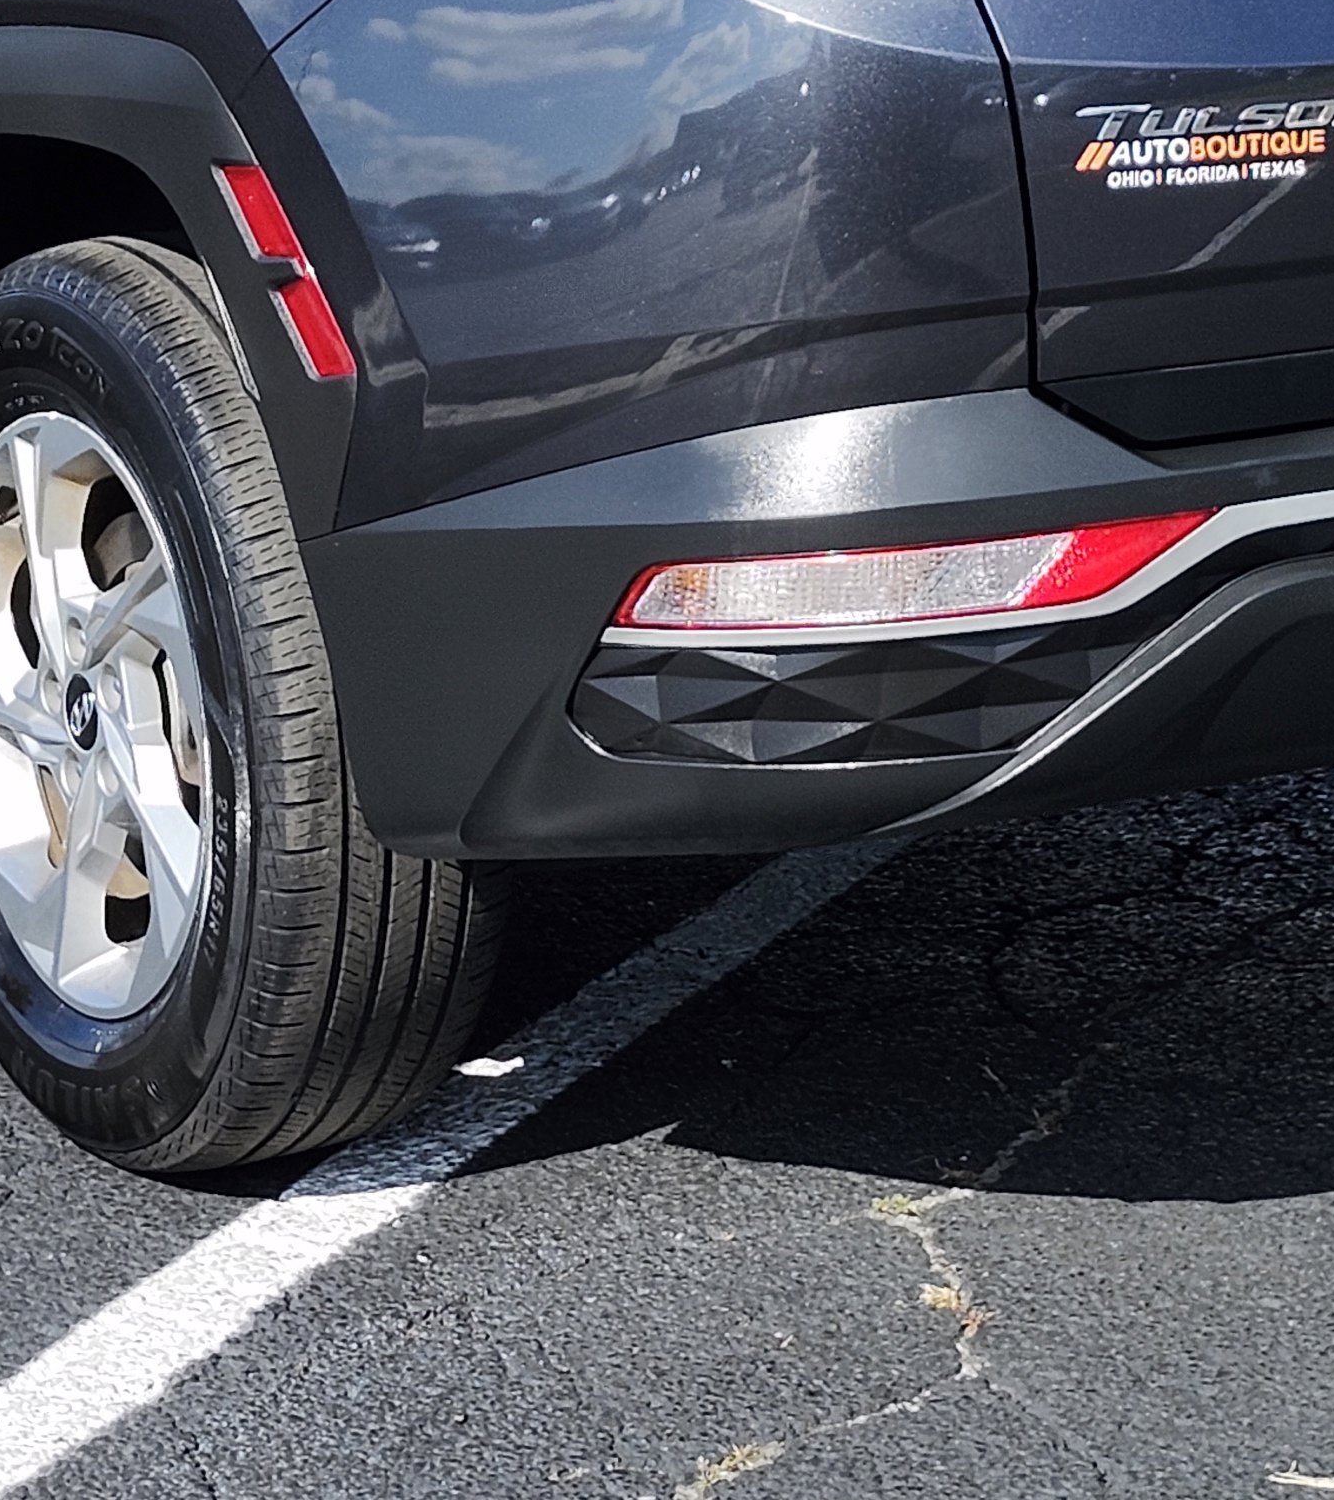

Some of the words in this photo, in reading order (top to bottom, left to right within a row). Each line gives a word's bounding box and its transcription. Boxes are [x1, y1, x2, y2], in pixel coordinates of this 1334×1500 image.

[1110, 129, 1328, 167] AUTOBOUTIQUE
[1107, 168, 1154, 189] OHIO
[1166, 164, 1240, 186] FLORIDA
[1249, 159, 1307, 180] TEXAS
